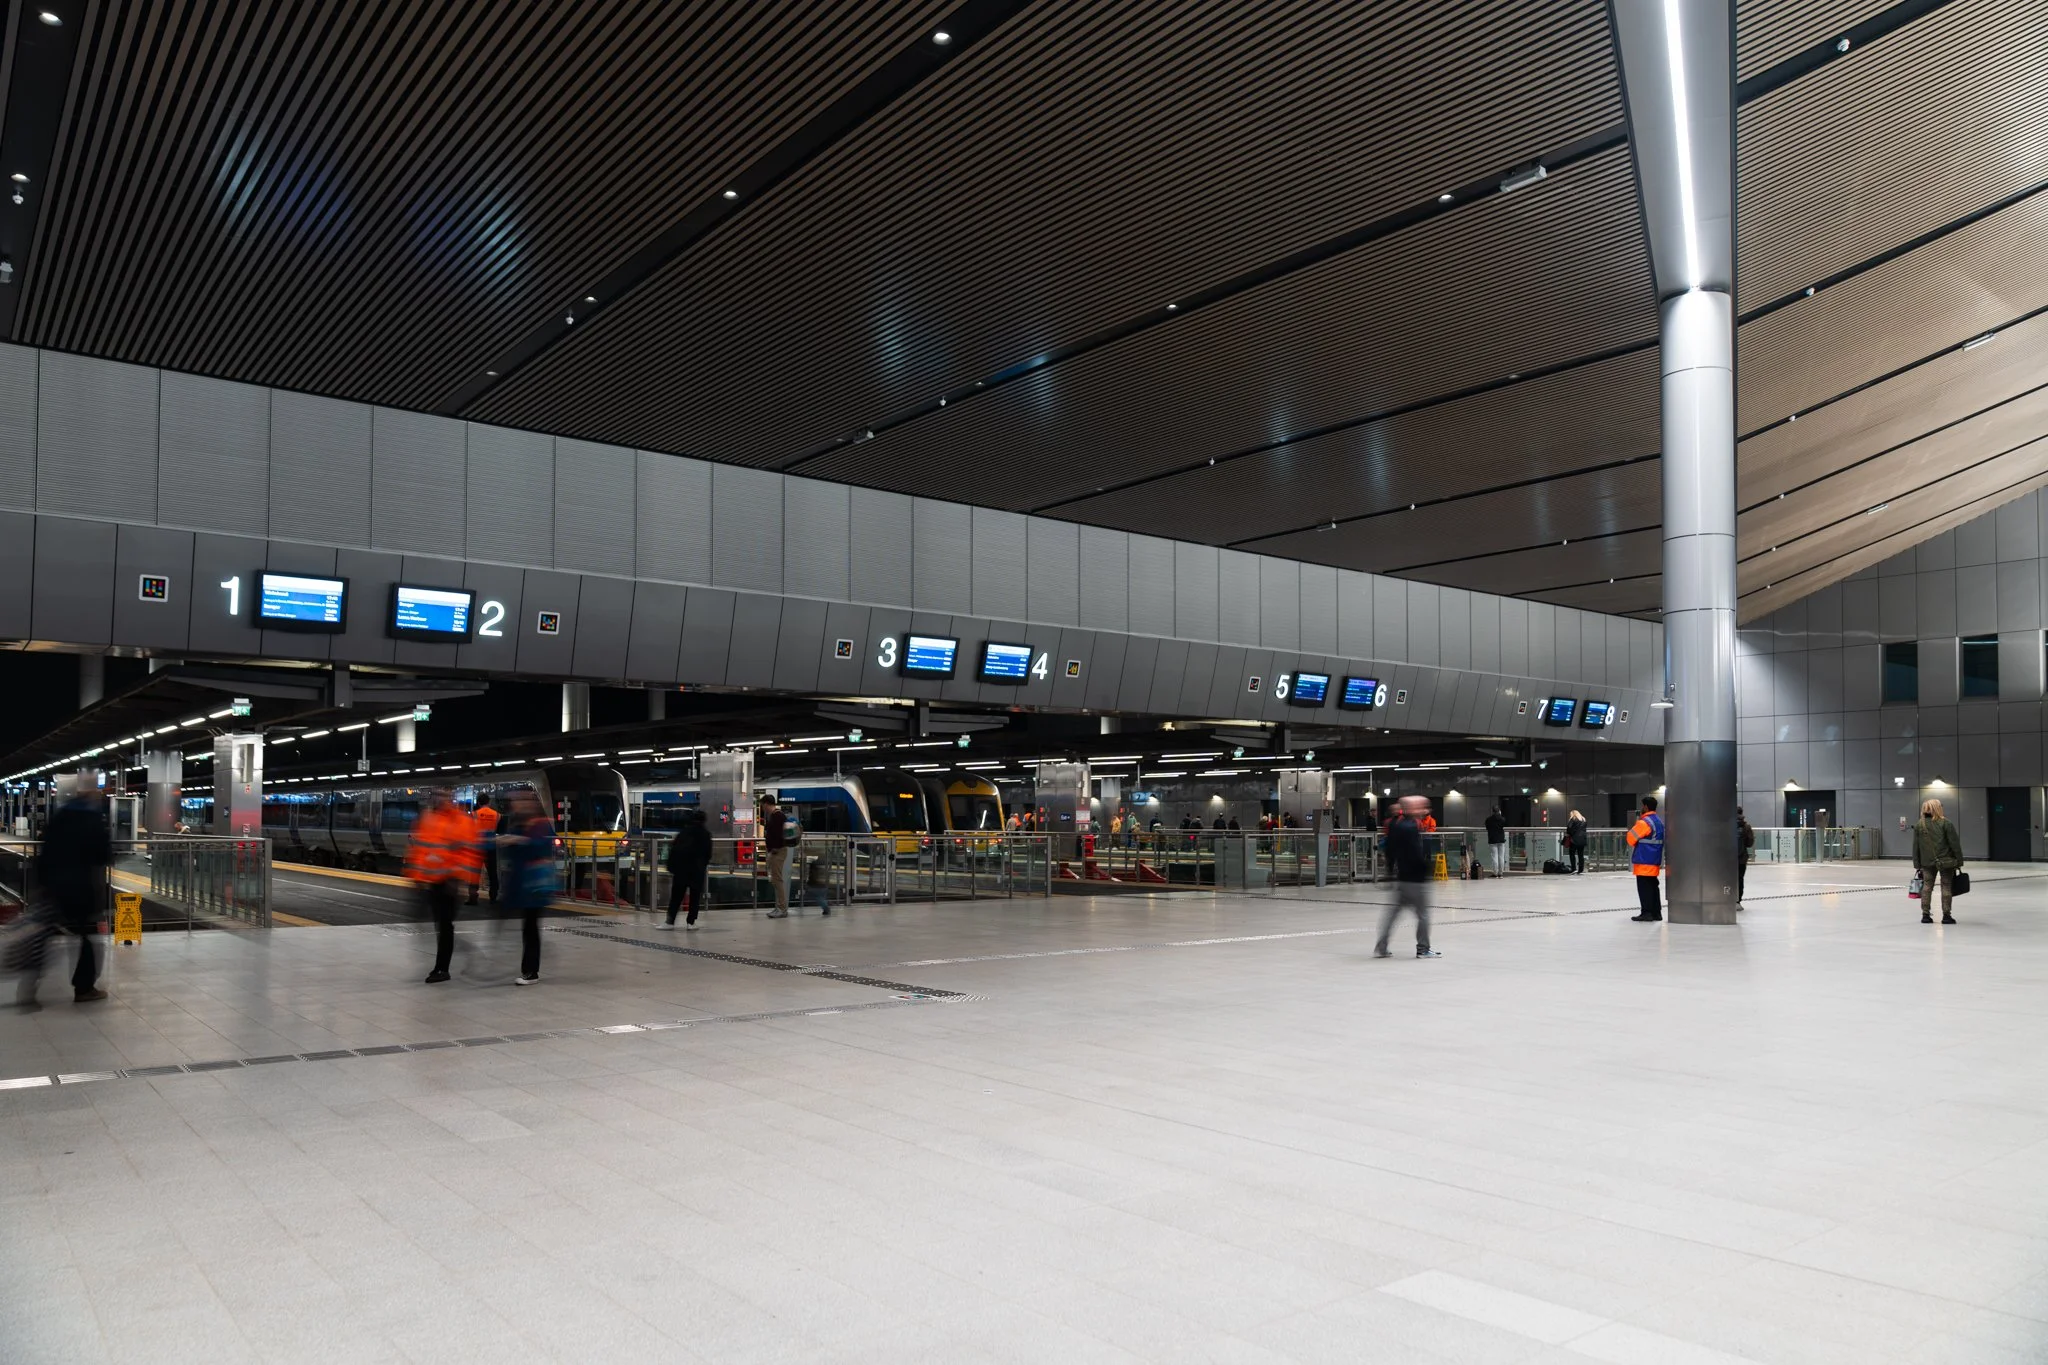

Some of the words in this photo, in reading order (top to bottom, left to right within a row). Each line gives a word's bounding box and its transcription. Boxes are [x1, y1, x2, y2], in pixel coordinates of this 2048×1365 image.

[221, 576, 240, 615] 1
[479, 600, 505, 637] 2
[877, 637, 897, 668] 3
[1031, 652, 1048, 680] 4
[1275, 674, 1290, 699] 5
[1374, 684, 1388, 707] 6
[1538, 700, 1549, 720] 7
[1604, 705, 1616, 726] 8
